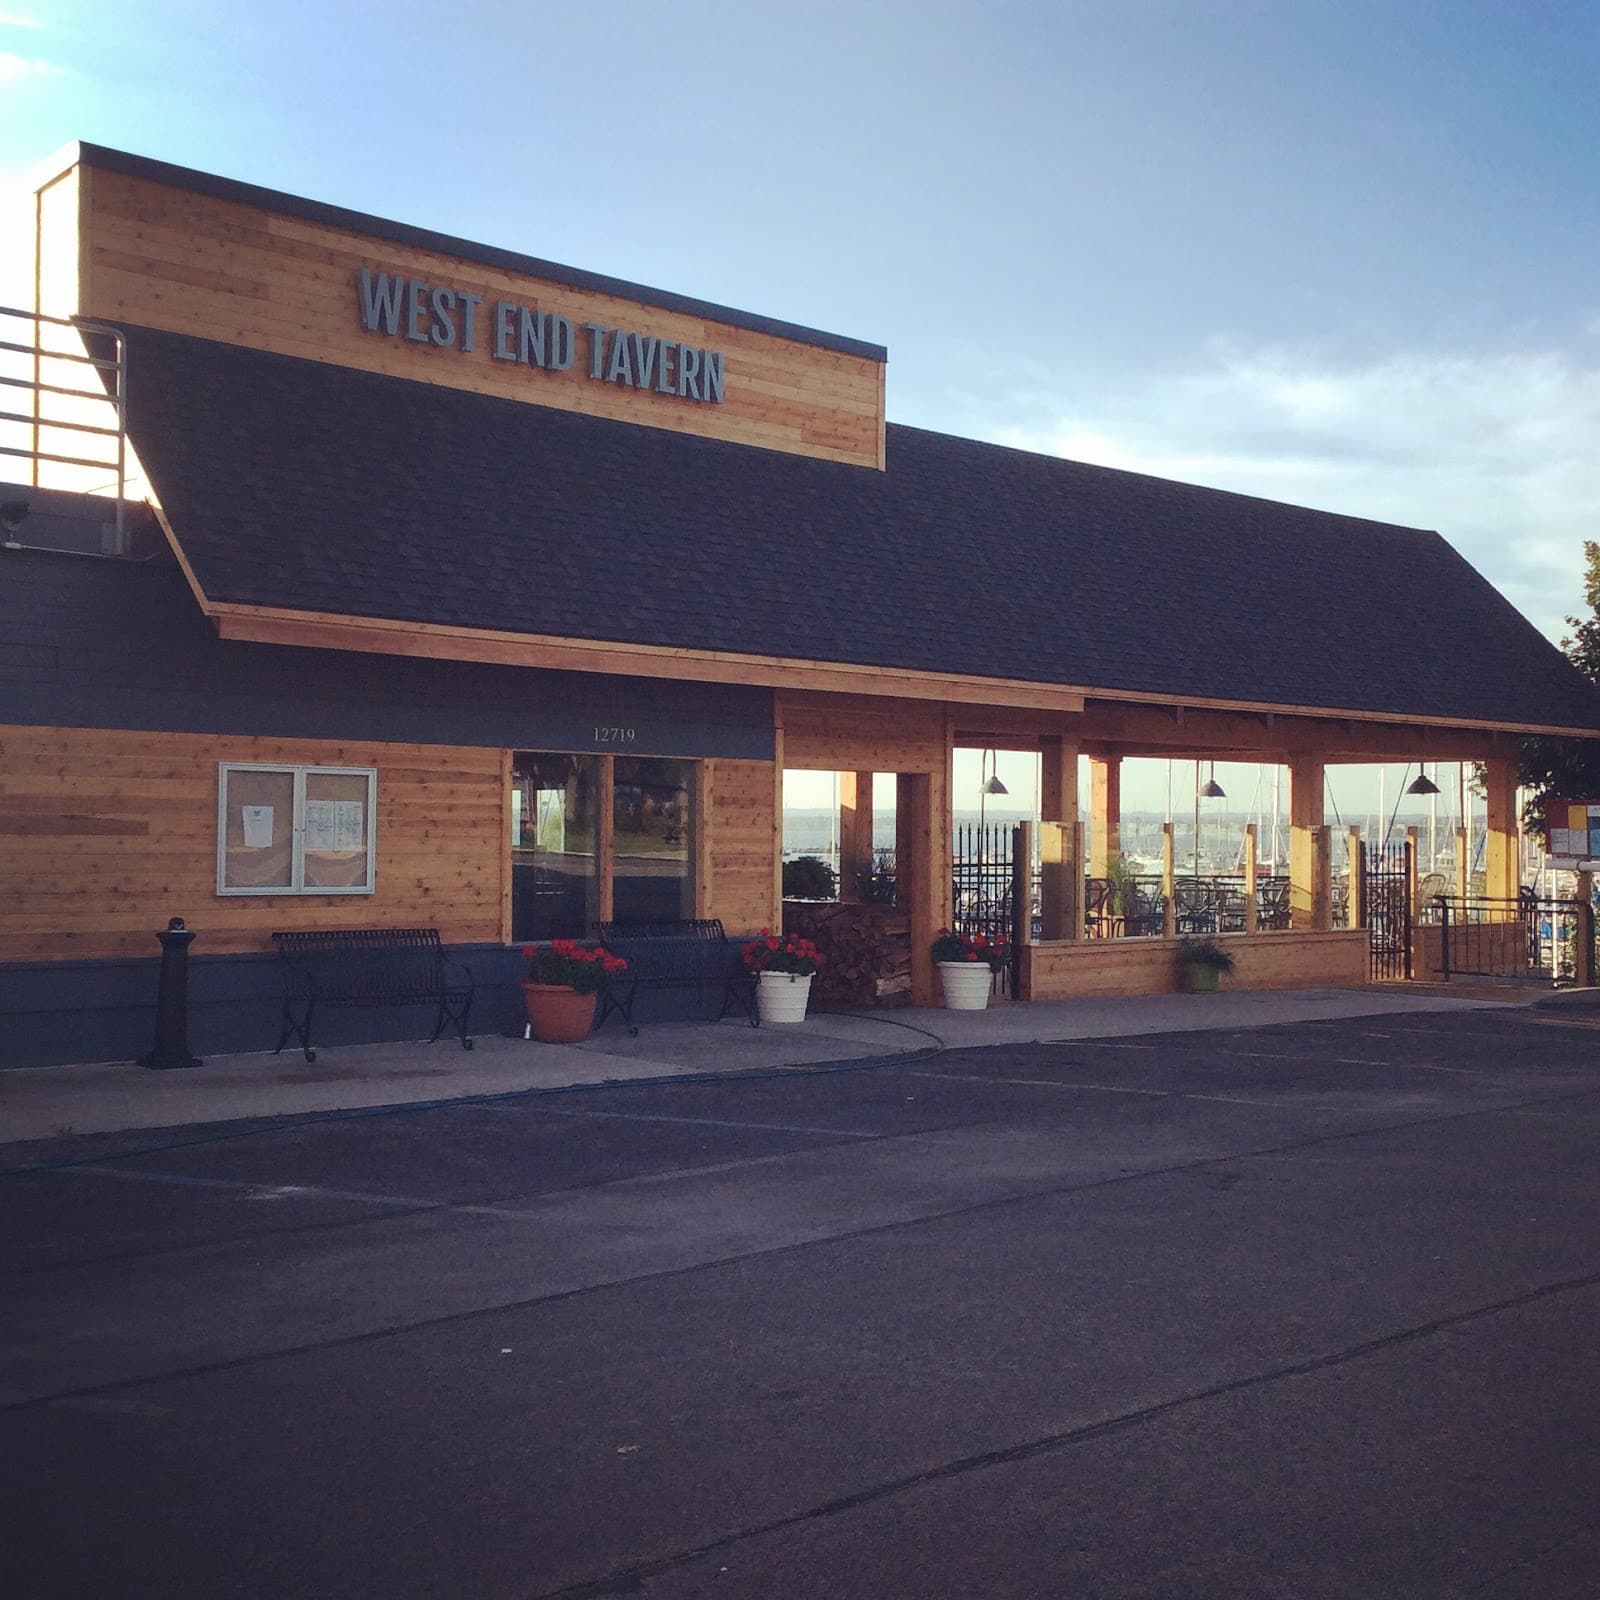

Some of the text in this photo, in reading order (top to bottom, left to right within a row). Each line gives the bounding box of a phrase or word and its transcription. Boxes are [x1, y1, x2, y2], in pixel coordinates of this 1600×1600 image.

[359, 268, 725, 404] WEST END TAVERN
[594, 727, 636, 742] 12719
